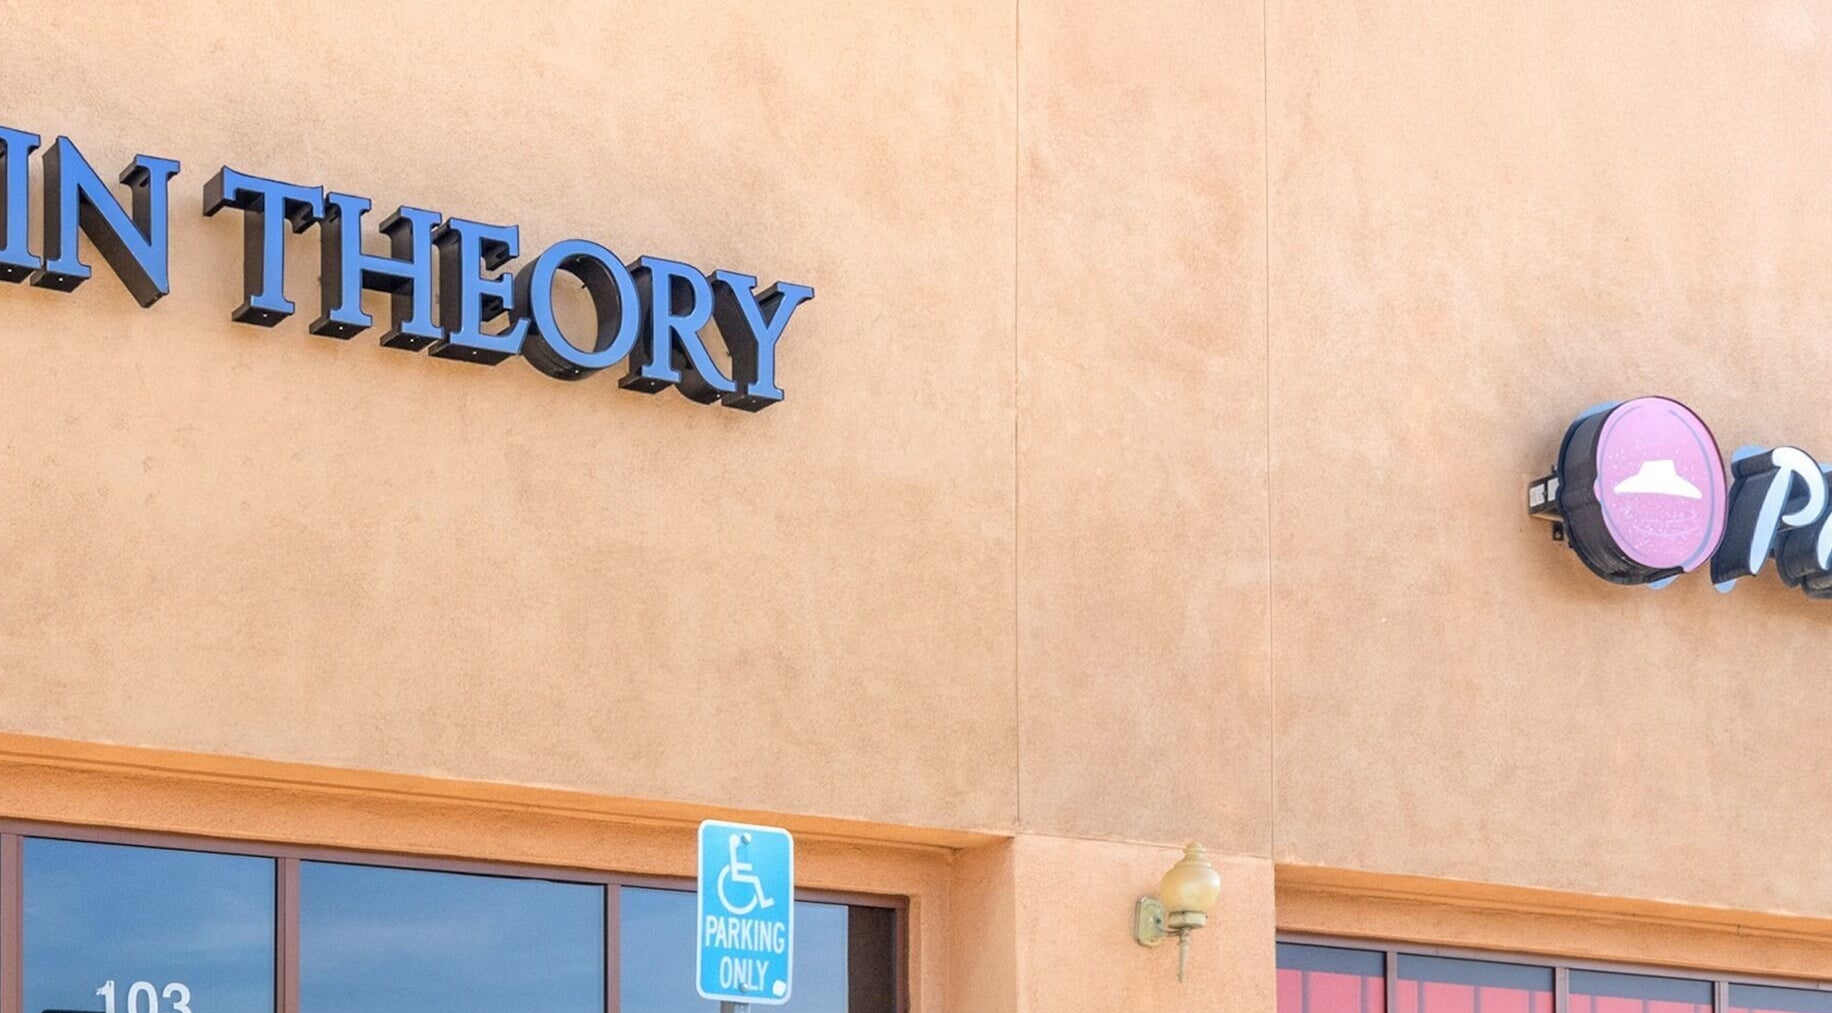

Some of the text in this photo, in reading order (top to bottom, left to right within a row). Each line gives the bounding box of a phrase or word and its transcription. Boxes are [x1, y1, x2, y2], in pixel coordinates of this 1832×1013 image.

[204, 164, 815, 411] THEORY
[1743, 445, 1832, 580] P
[705, 915, 785, 954] PARKING
[719, 955, 770, 992] ONLY
